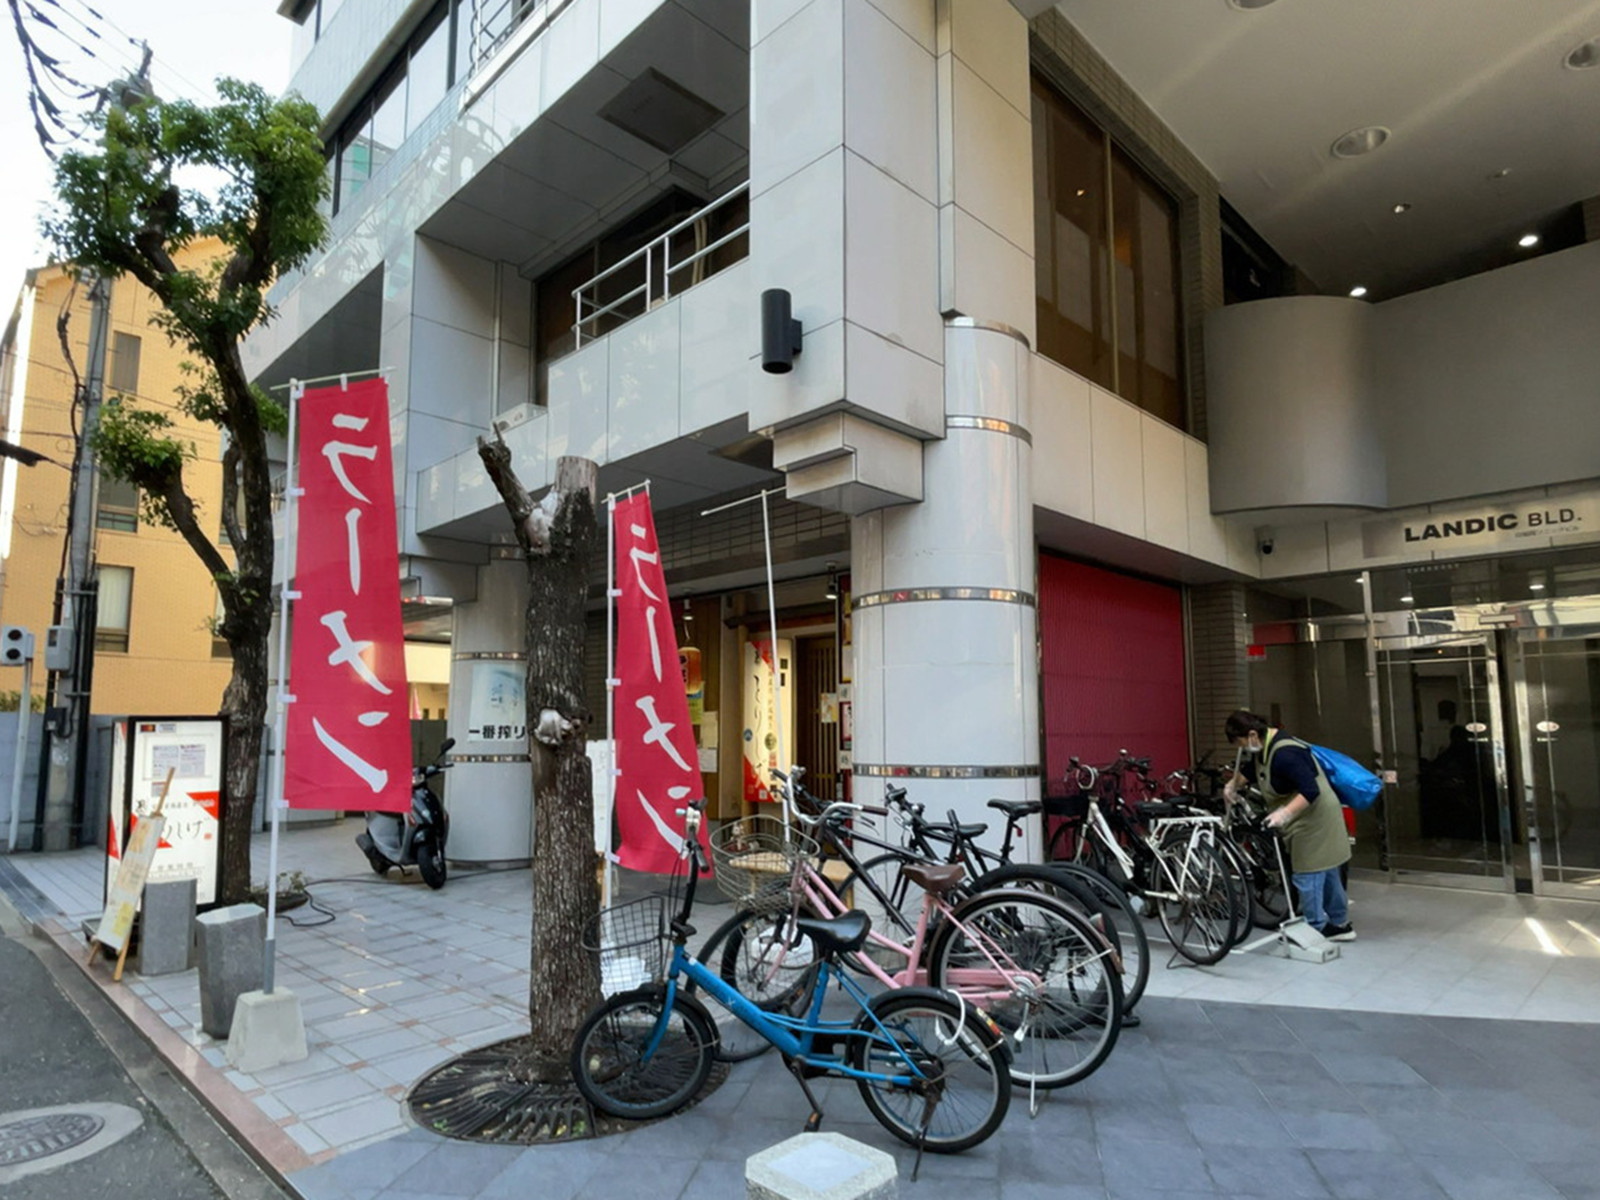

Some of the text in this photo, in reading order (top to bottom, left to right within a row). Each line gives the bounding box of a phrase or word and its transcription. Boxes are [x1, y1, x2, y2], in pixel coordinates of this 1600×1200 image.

[312, 412, 393, 793] ラーメン
[1404, 513, 1519, 542] LANDIC
[1528, 508, 1582, 527] BLD.
[468, 725, 526, 740] 一番搾り
[630, 523, 693, 860] ラーメン
